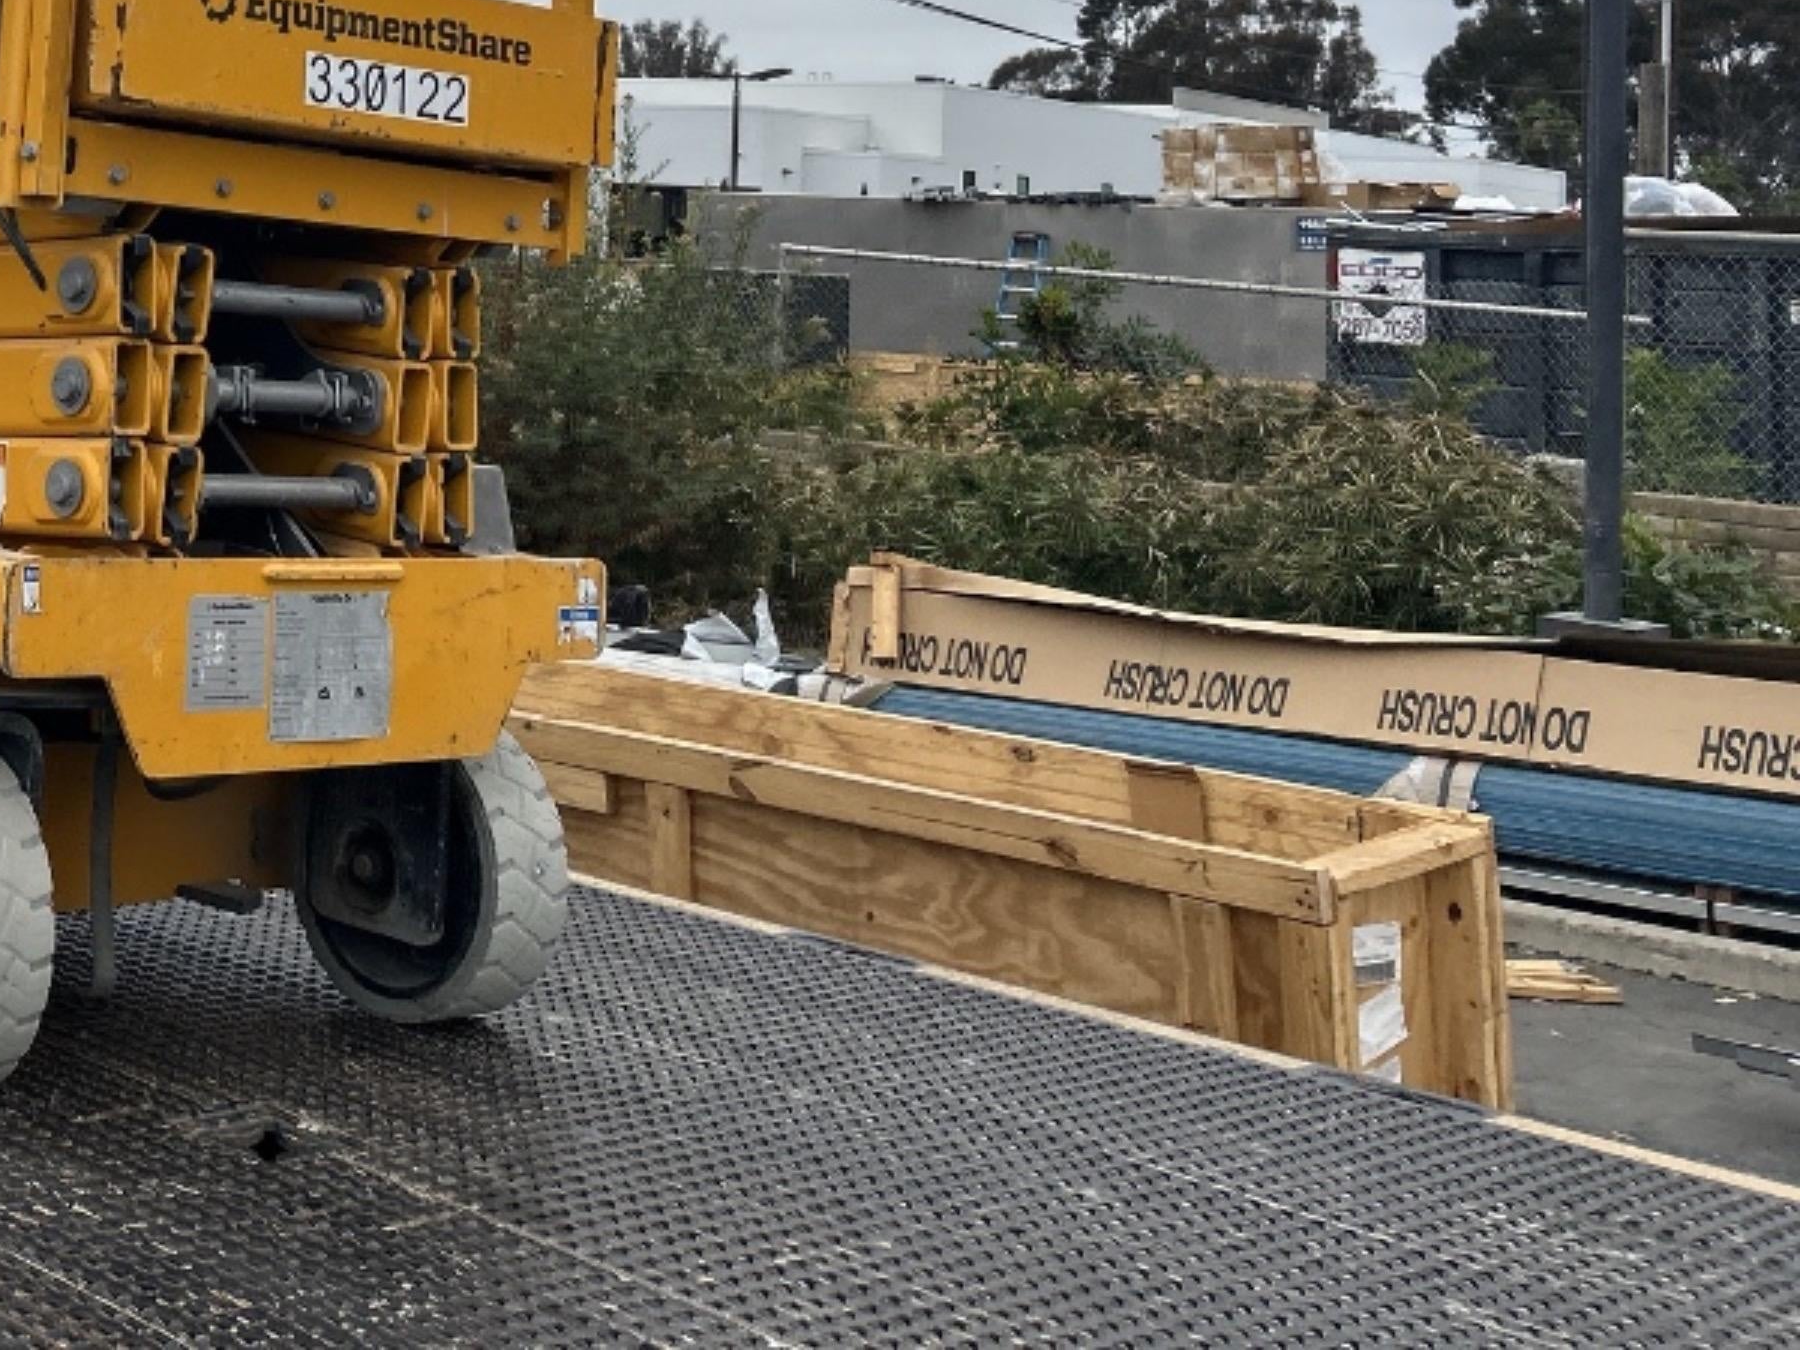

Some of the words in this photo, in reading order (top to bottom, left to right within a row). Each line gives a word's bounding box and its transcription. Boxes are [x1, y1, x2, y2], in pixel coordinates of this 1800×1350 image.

[307, 54, 466, 124] 330122
[938, 638, 990, 680] NOT
[989, 644, 1029, 685] DO
[1104, 659, 1190, 706] CRUSH
[1188, 669, 1246, 712] NOT
[1248, 674, 1290, 718] DO
[1376, 689, 1478, 739] CRUSH
[1479, 699, 1538, 748] NOT
[1541, 706, 1591, 754] DO
